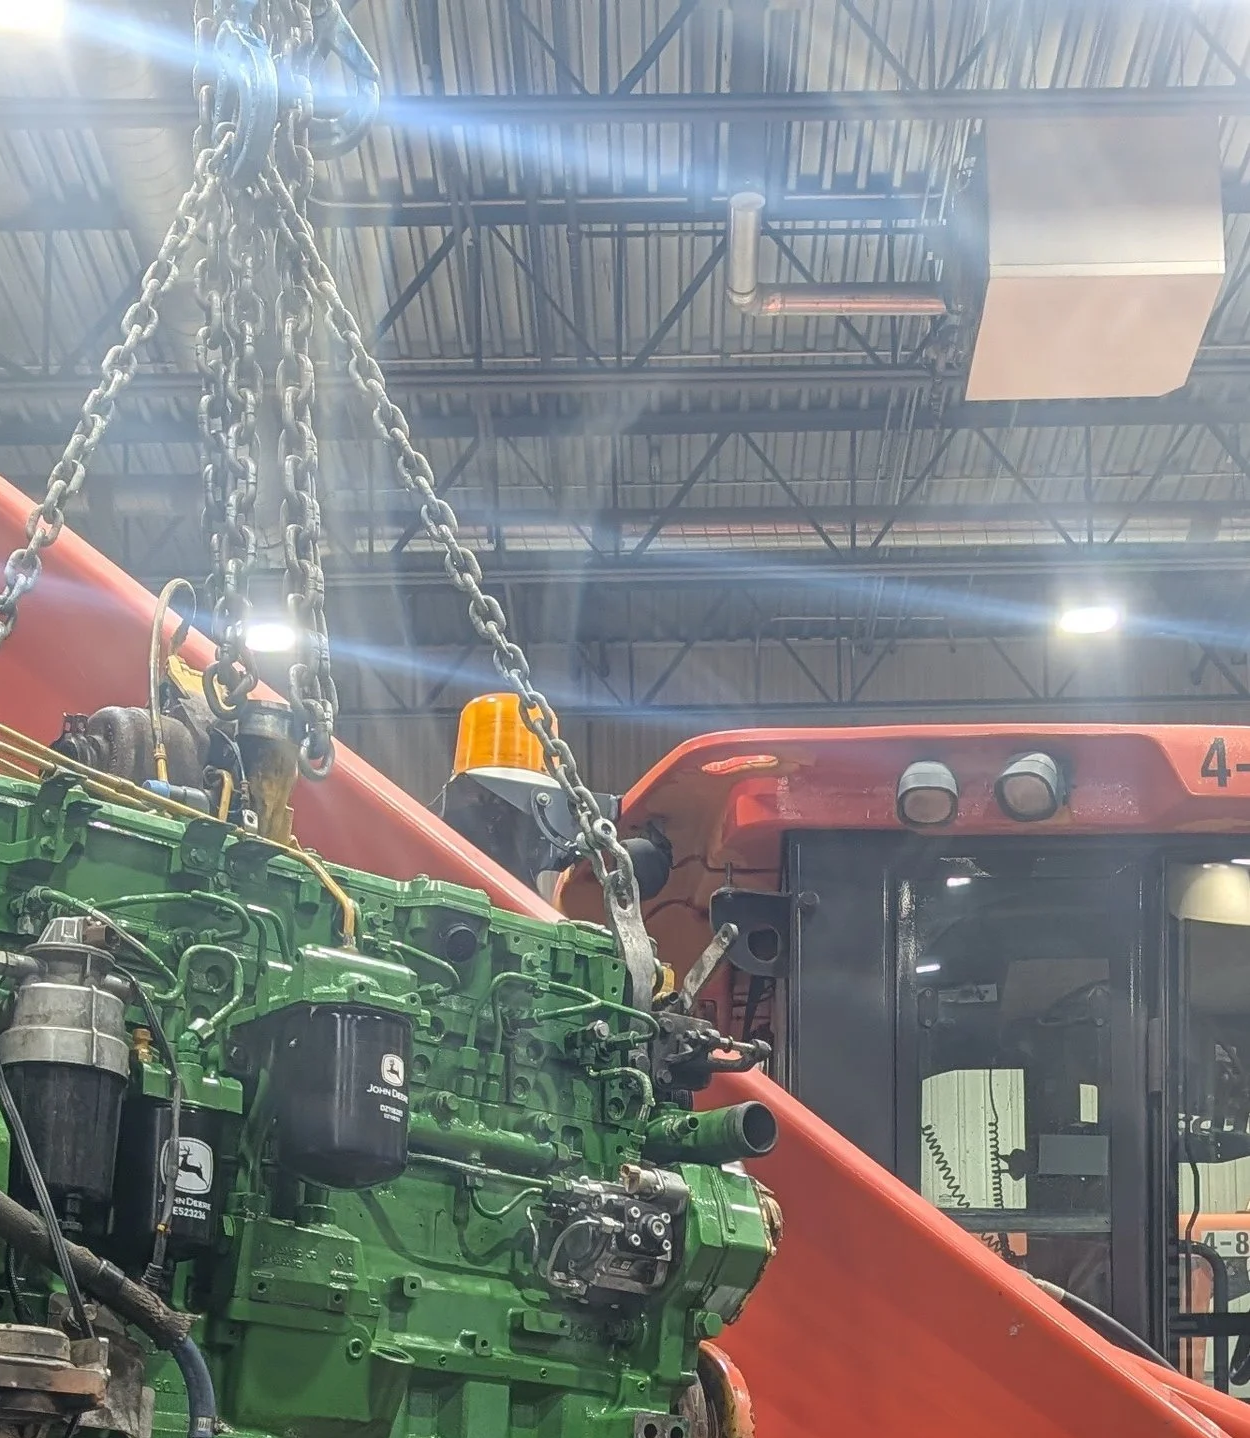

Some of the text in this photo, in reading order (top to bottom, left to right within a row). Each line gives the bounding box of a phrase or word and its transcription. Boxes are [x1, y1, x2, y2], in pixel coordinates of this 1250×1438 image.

[366, 1083, 391, 1097] JOHN
[158, 1194, 211, 1211] JHN DEERE
[172, 1206, 206, 1220] E523236
